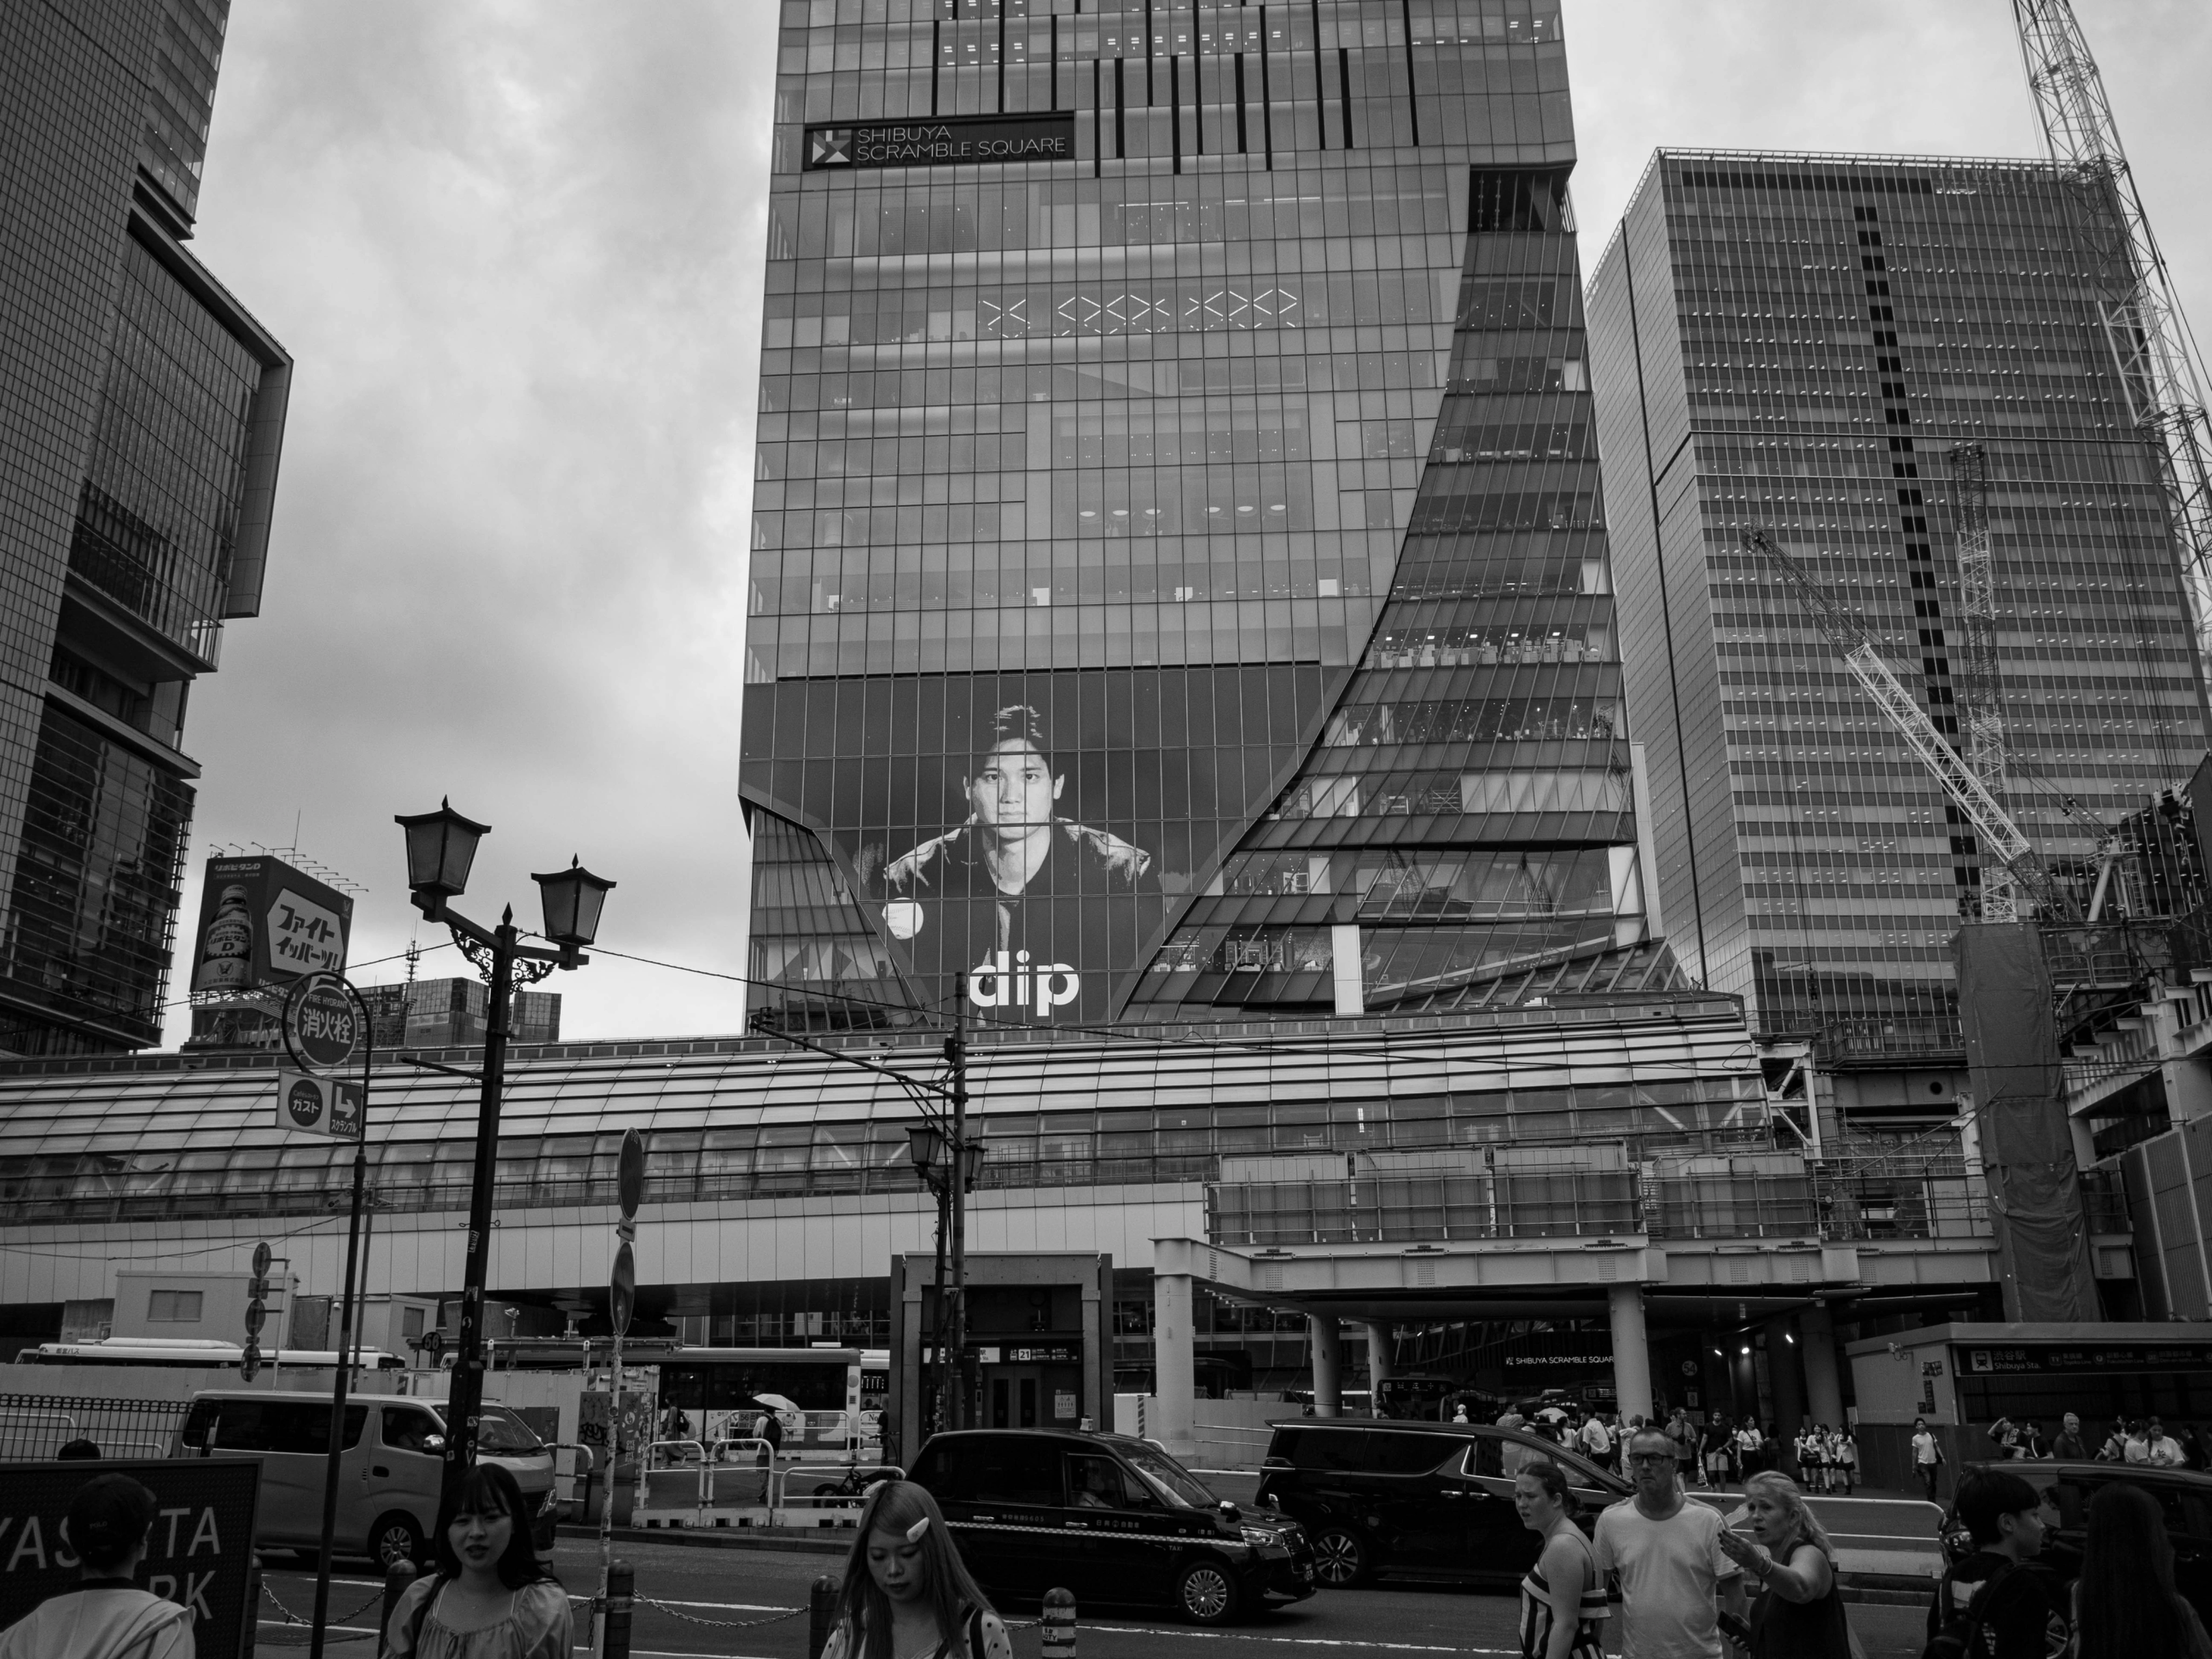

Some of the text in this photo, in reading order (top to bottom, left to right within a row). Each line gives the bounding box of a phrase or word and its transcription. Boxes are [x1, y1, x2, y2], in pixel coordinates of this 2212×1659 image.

[858, 125, 951, 144] SHIBUYA
[857, 137, 1065, 161] SCRAMBLE SQUARE
[277, 903, 335, 943] ファイト
[969, 949, 1080, 1016] dip
[308, 994, 348, 1009] FIRE HYDRANT
[301, 1007, 352, 1044] 消火栓
[292, 1098, 320, 1114] ガスト
[331, 1119, 358, 1133] スクランブル
[1515, 1355, 1615, 1365] SHIBUYA SCRAMBLE SQUAR
[1993, 1348, 2026, 1361] 渋谷駅
[1684, 1363, 1696, 1373] 54
[1994, 1361, 2041, 1371] Shibuya Sta.
